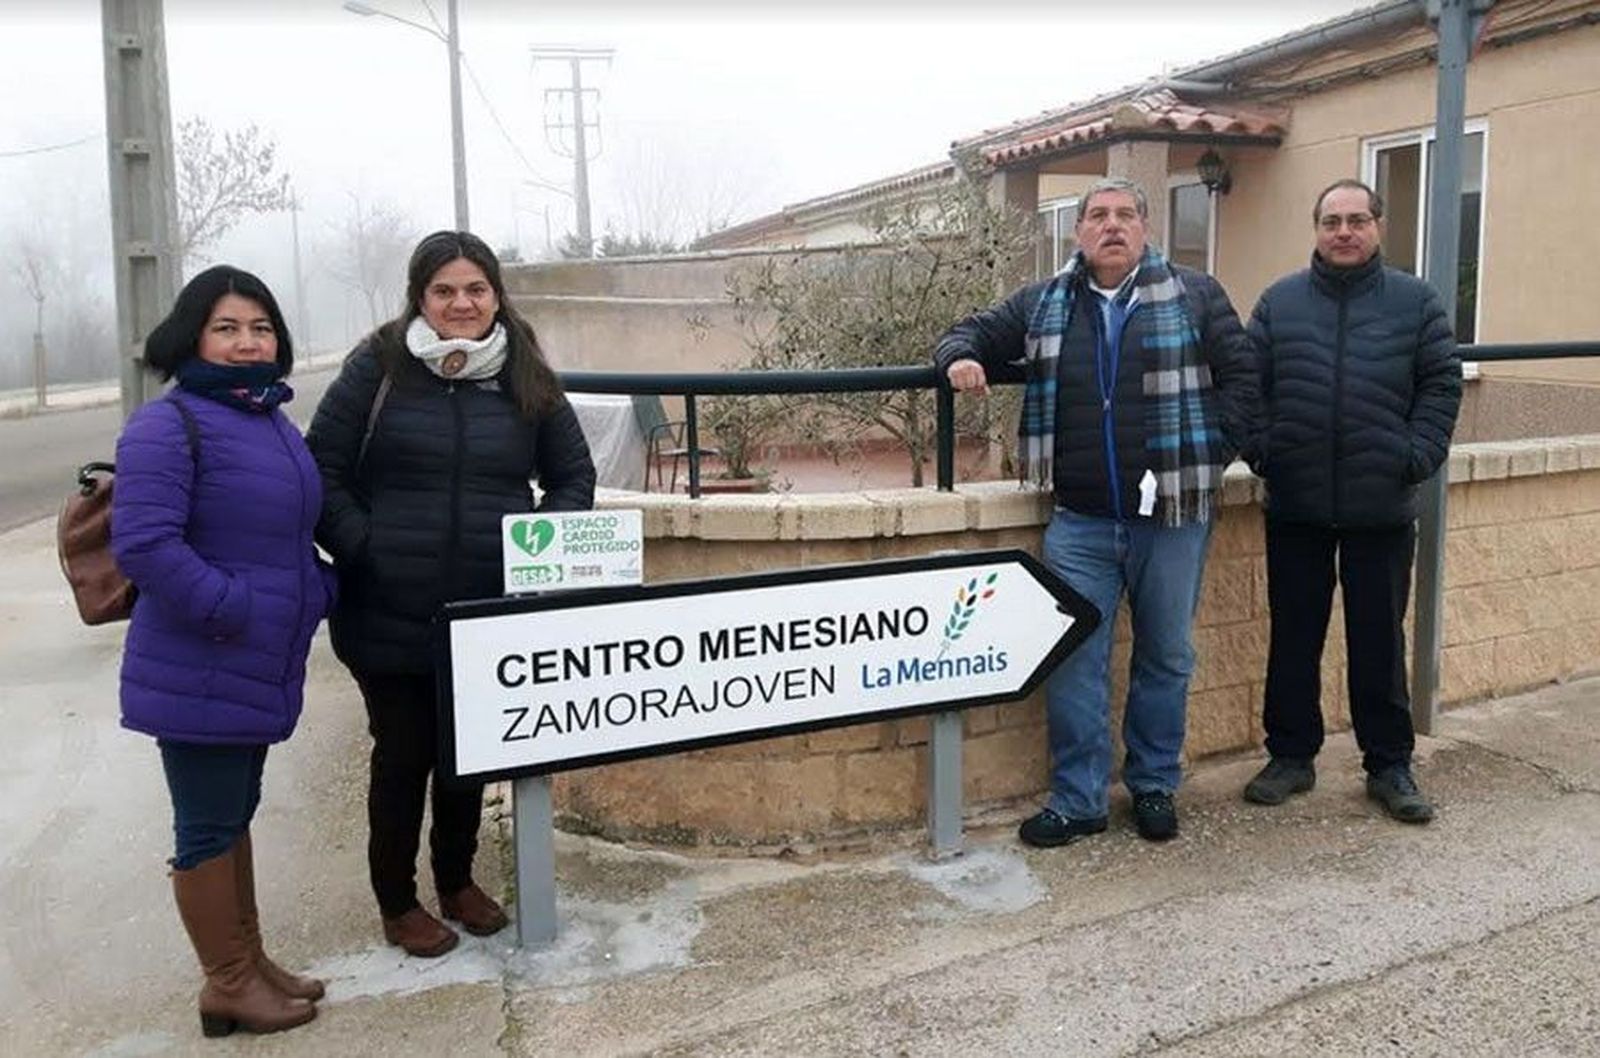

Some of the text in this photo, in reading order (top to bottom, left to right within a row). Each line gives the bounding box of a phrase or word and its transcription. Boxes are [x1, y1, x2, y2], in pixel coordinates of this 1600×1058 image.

[562, 516, 618, 530] ESPACIO
[563, 529, 614, 543] CARDIO
[564, 540, 640, 555] PROTEGIDO
[496, 605, 929, 689] CENTRO MENESIANO
[862, 650, 1008, 689] La Mennais
[501, 664, 836, 743] ZAMORAJOVEN
